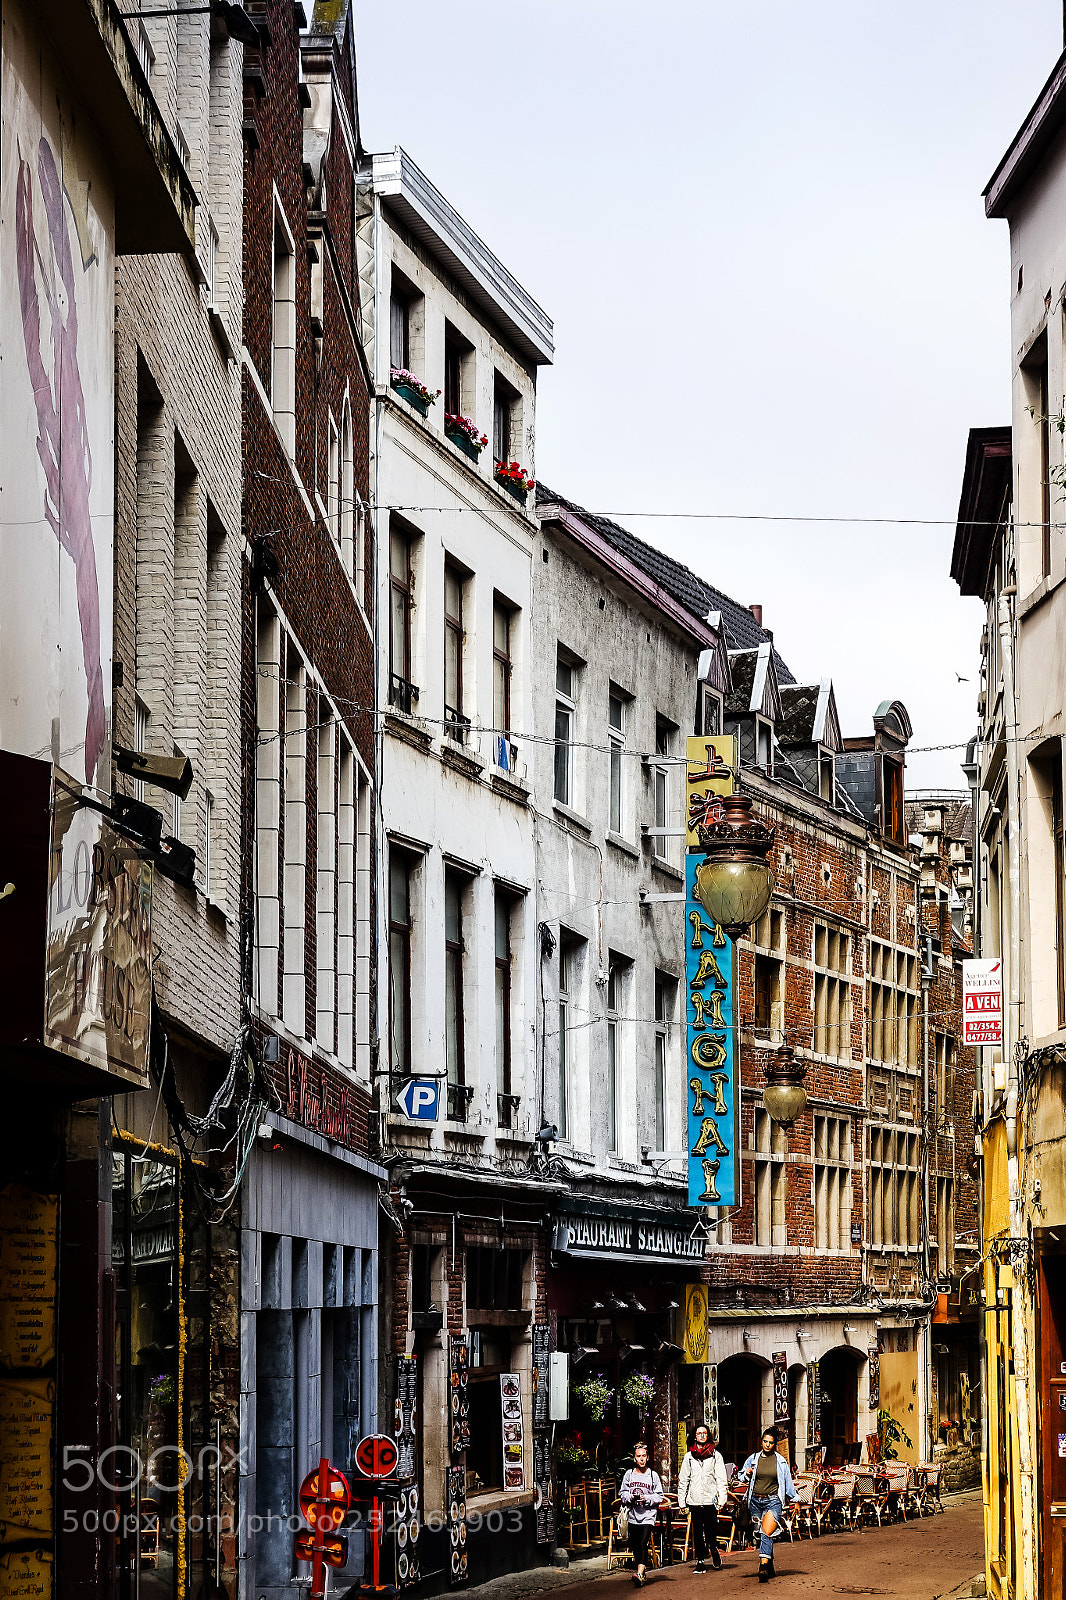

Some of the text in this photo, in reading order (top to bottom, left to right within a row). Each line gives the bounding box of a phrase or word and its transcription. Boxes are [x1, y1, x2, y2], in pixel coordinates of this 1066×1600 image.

[966, 996, 974, 1010] A
[688, 862, 730, 1203] HANGHAI
[411, 1086, 436, 1115] P
[551, 1214, 706, 1258] STAURANT SHANGHAI
